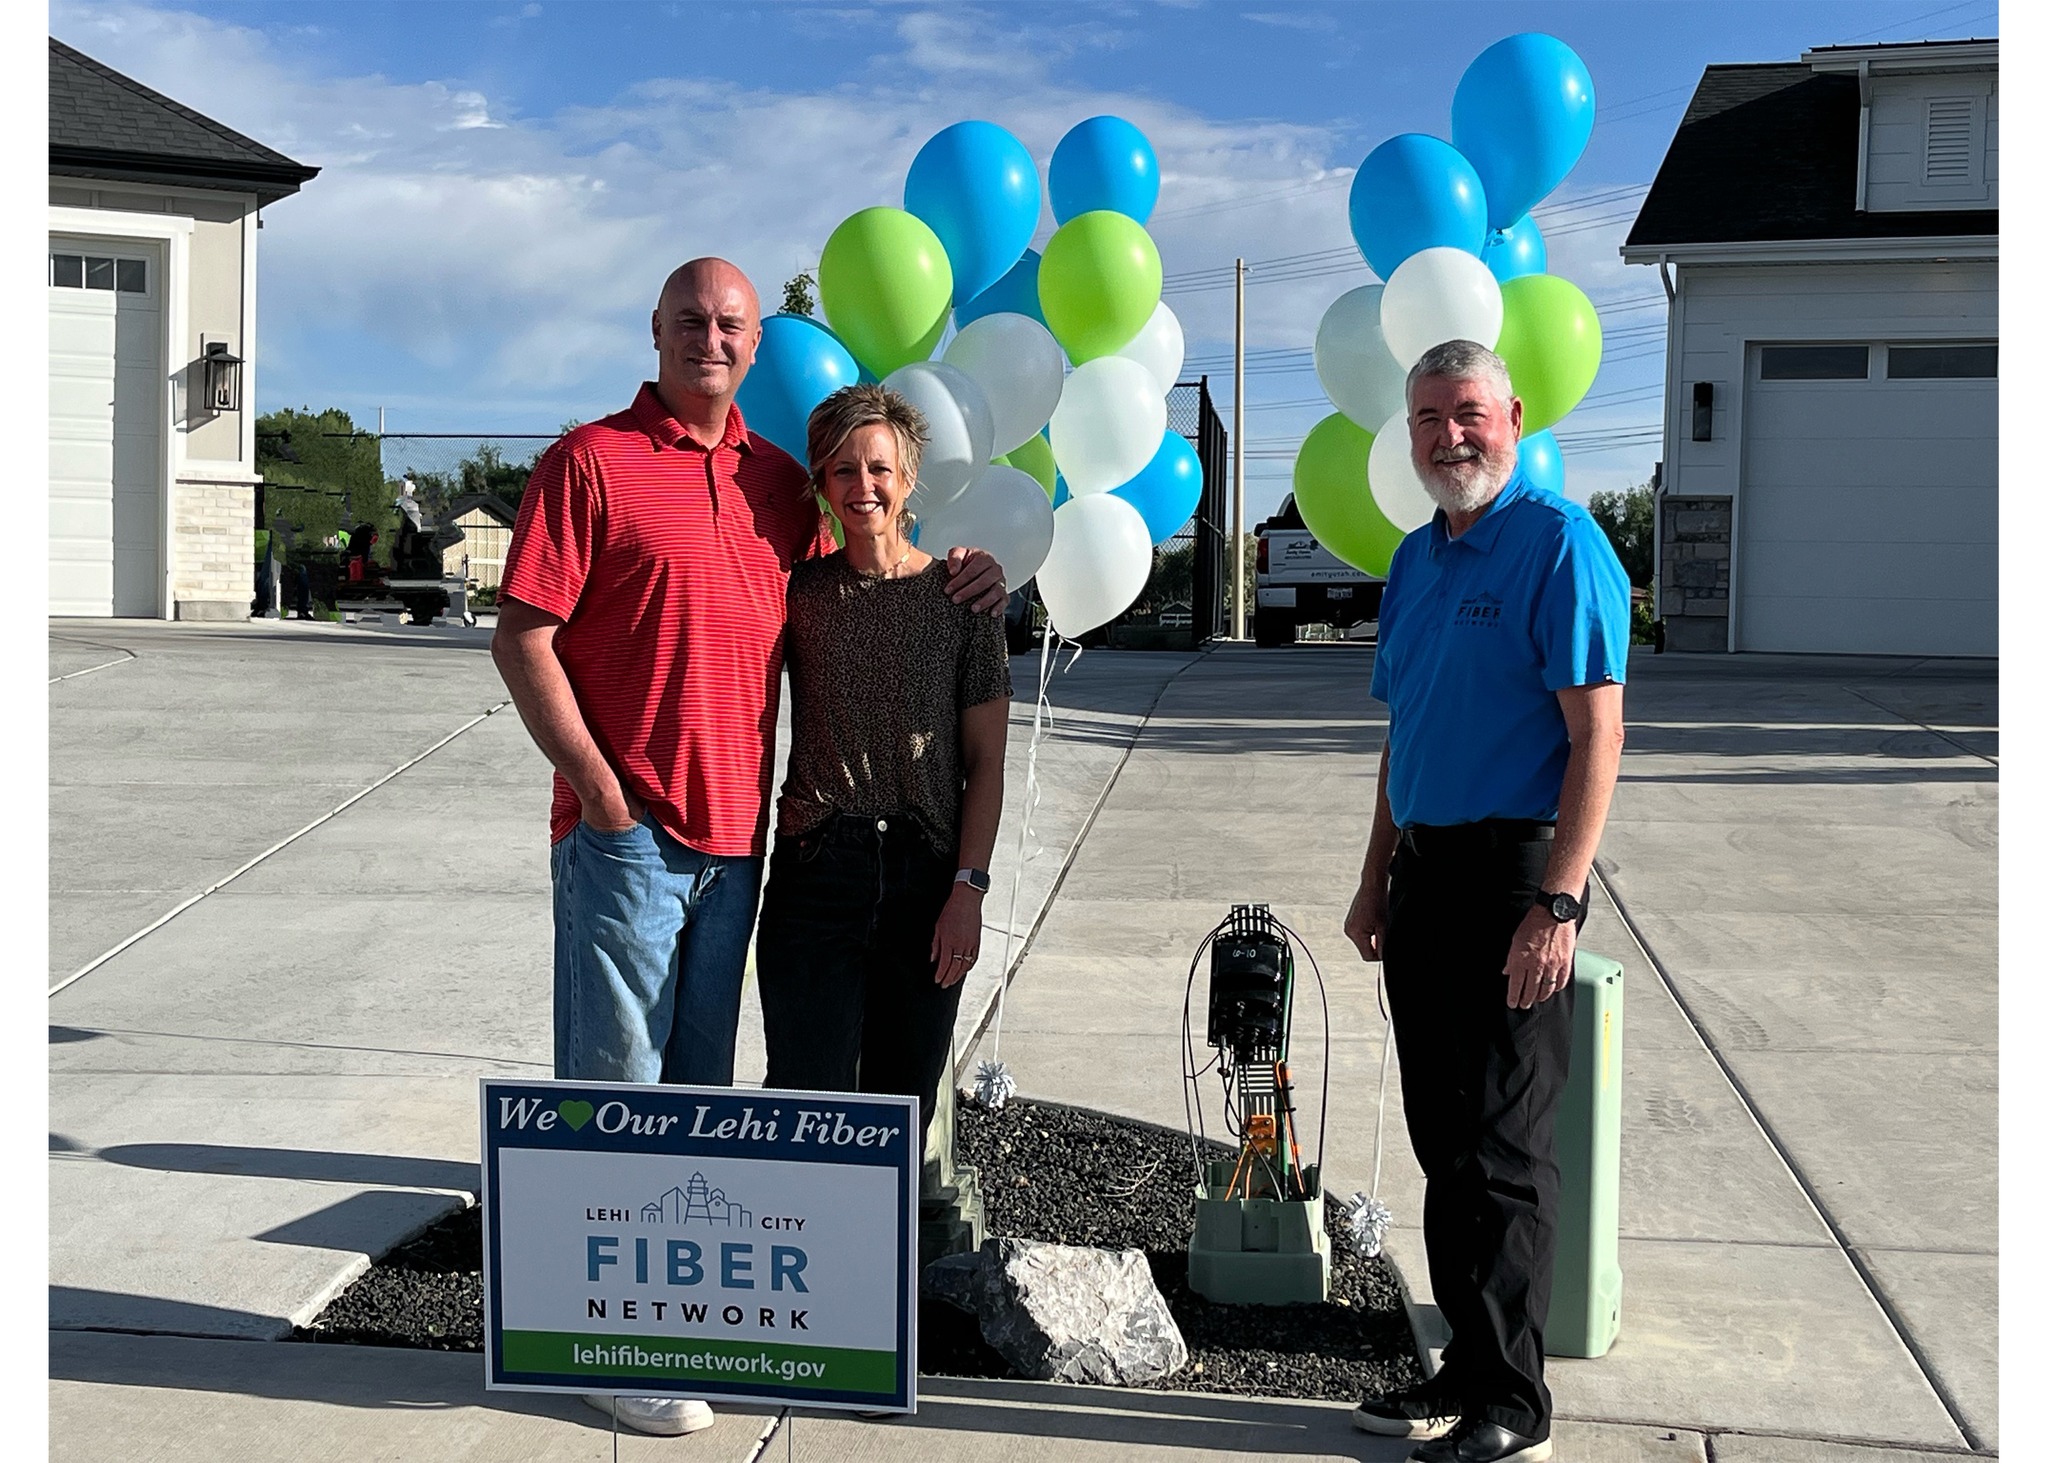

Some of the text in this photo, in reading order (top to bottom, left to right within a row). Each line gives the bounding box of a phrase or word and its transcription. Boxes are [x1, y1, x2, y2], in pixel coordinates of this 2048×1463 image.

[1457, 606, 1501, 619] FIBER
[499, 1097, 899, 1148] We Our Lehi Fiber
[586, 1207, 806, 1231] LEHI CITY
[586, 1235, 810, 1293] FIBER
[587, 1299, 809, 1330] NETWORK
[573, 1343, 826, 1381] lehifibernetwork.gov
